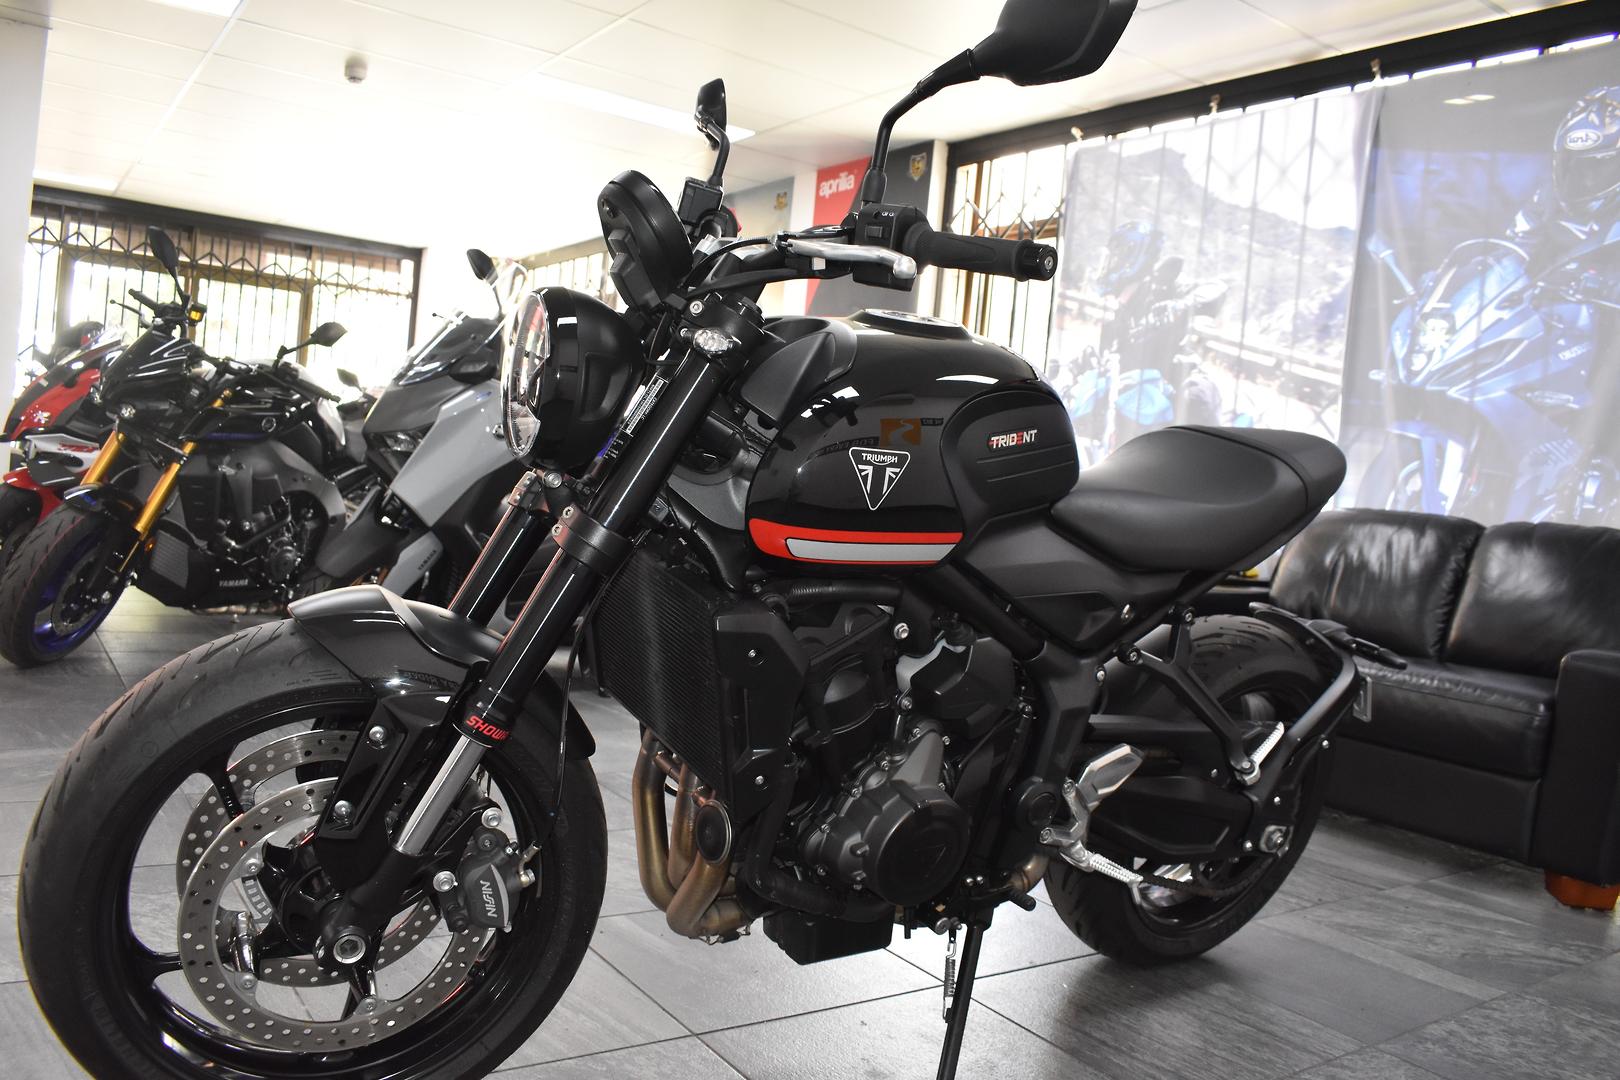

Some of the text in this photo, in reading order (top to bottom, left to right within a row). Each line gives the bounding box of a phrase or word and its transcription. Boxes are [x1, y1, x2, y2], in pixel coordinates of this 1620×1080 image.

[819, 172, 855, 199] aprilia
[990, 429, 1038, 449] TRIDENT
[862, 452, 898, 465] TRIUMPH
[219, 578, 249, 588] YAMAHA
[480, 880, 498, 918] NISSIN
